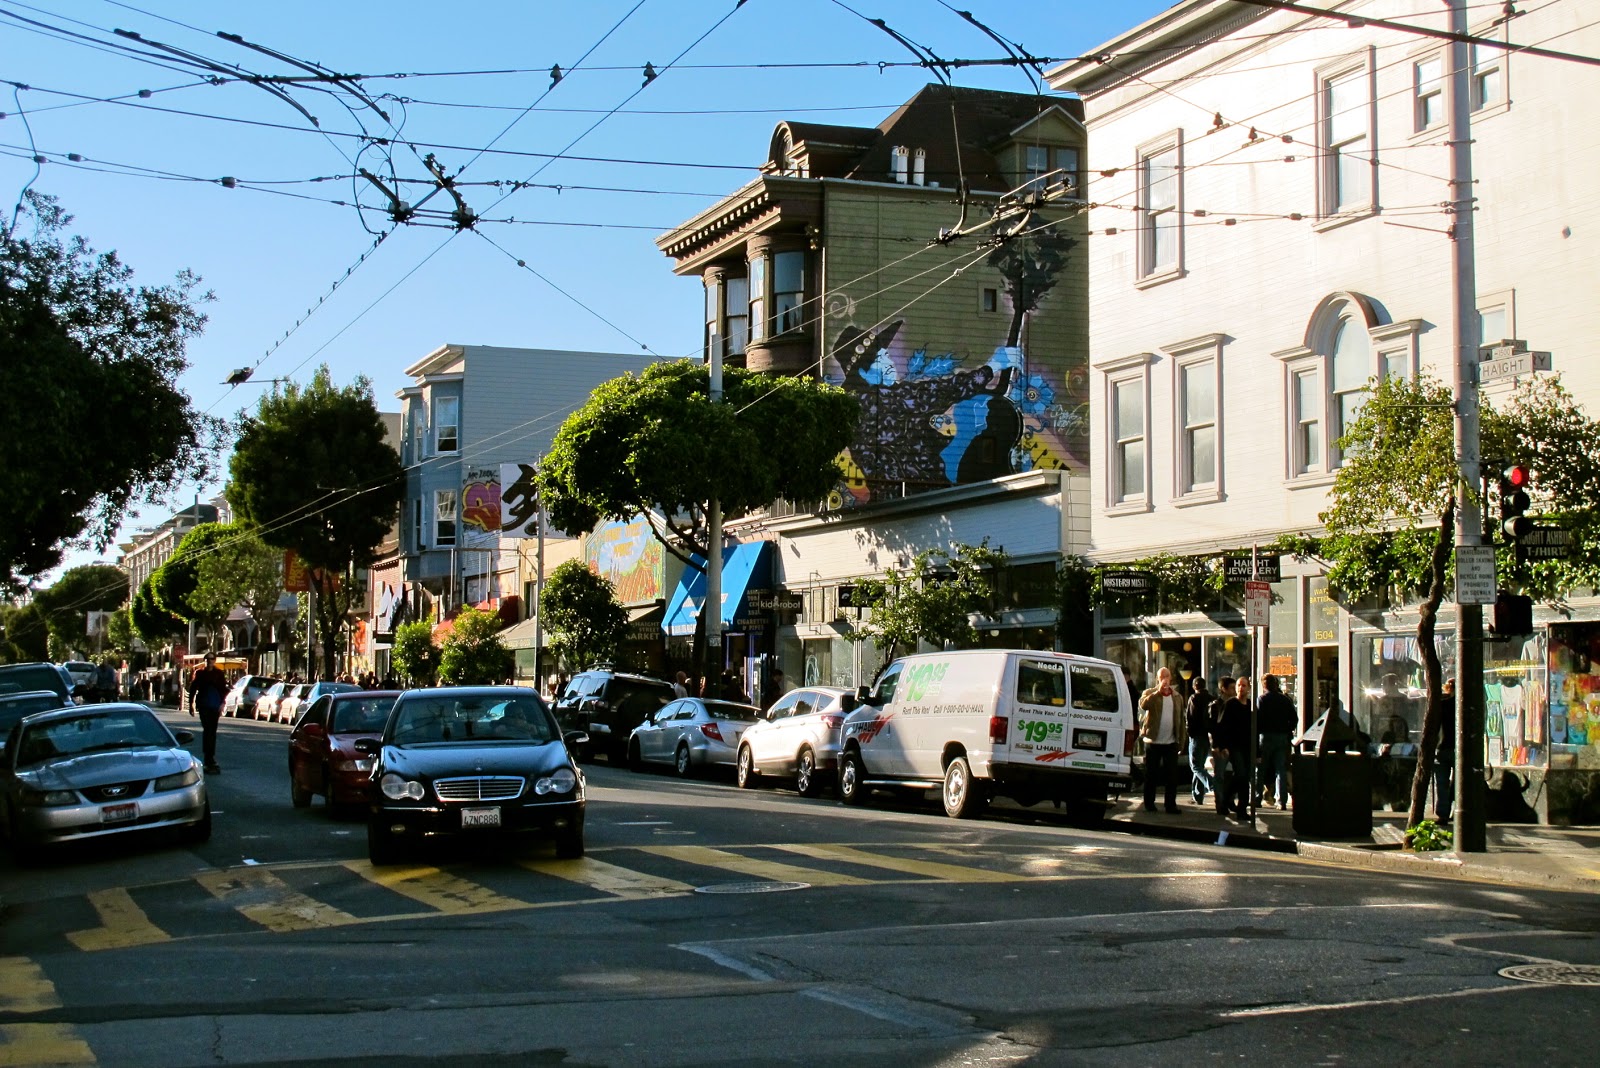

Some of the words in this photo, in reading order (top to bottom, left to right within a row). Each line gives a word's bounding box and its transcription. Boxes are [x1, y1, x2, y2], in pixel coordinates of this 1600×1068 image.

[1482, 359, 1524, 376] HAIGHT
[1546, 530, 1575, 545] ASHBU
[1227, 567, 1278, 575] JEWEERY
[1103, 577, 1130, 588] MYSTERY
[1314, 630, 1334, 640] 1504
[1037, 662, 1057, 670] Need
[1071, 665, 1089, 674] Van?
[933, 705, 943, 714] Call
[943, 704, 984, 714] 1-800-GO-U-HAUL
[1069, 712, 1113, 722] 1-800-GO-U-HAUL
